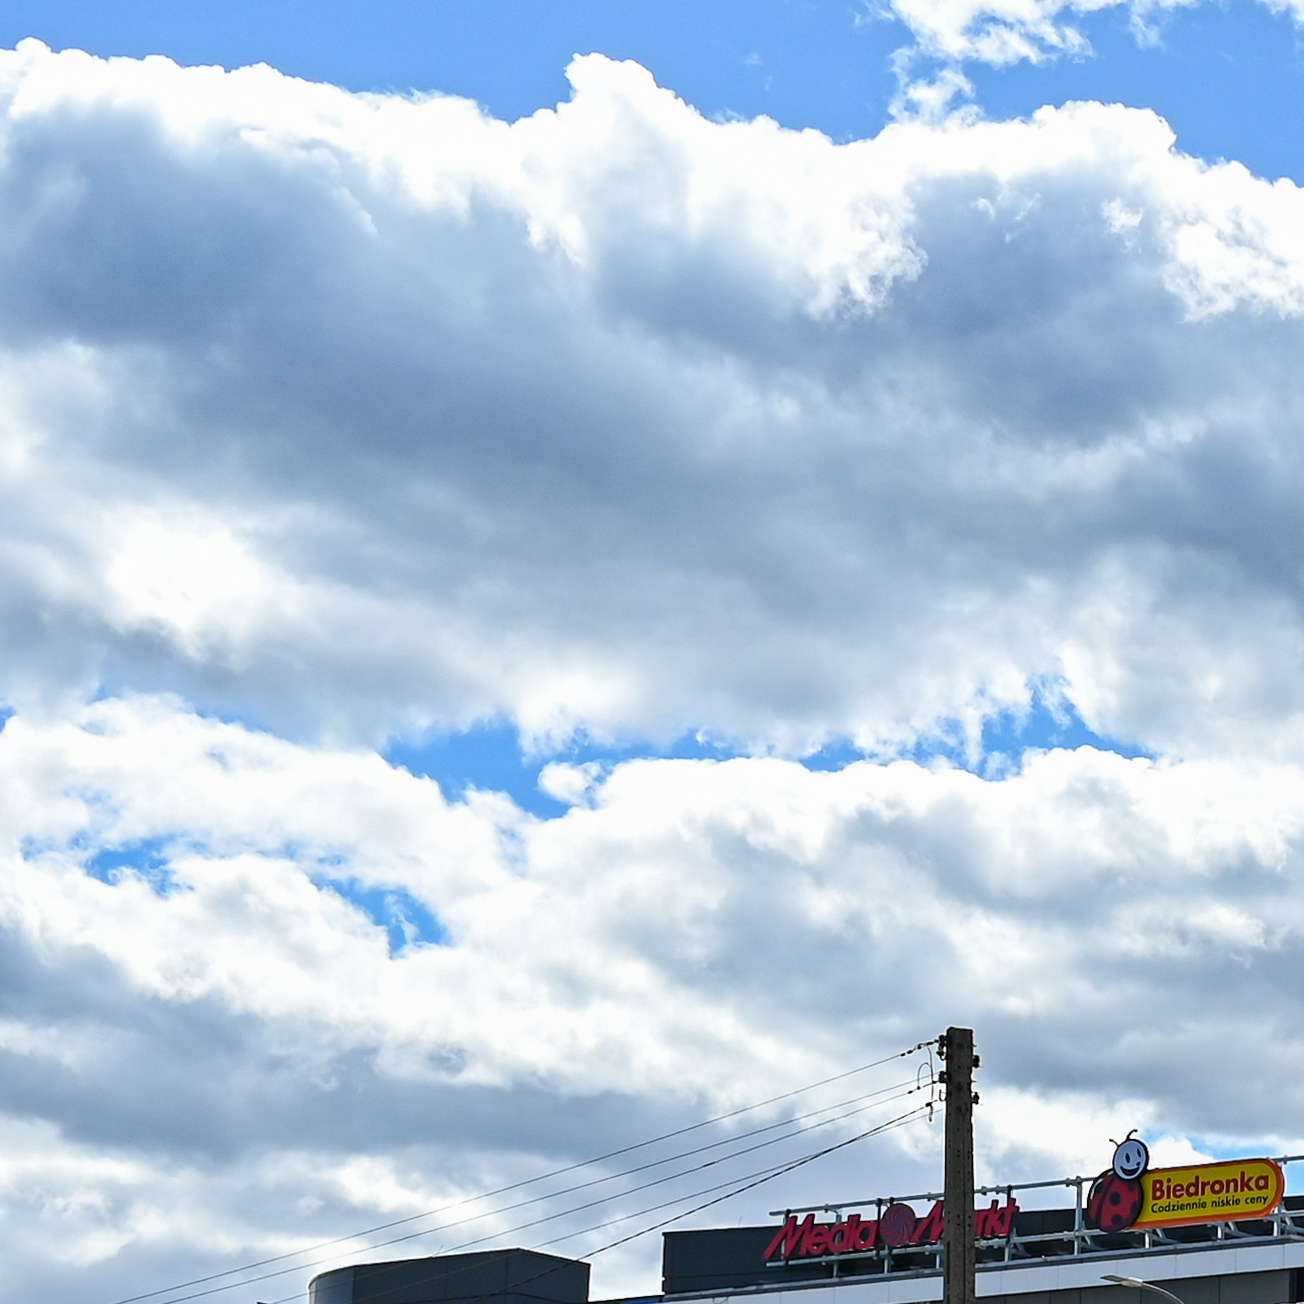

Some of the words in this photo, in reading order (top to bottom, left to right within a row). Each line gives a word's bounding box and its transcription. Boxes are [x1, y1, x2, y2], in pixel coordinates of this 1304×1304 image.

[1151, 1170, 1270, 1201] Biedronka
[1150, 1200, 1208, 1214] Codziennie
[1211, 1195, 1241, 1208] niskie
[1244, 1195, 1269, 1205] ceny
[763, 1213, 880, 1260] Media
[908, 1197, 1020, 1246] Mrkt
